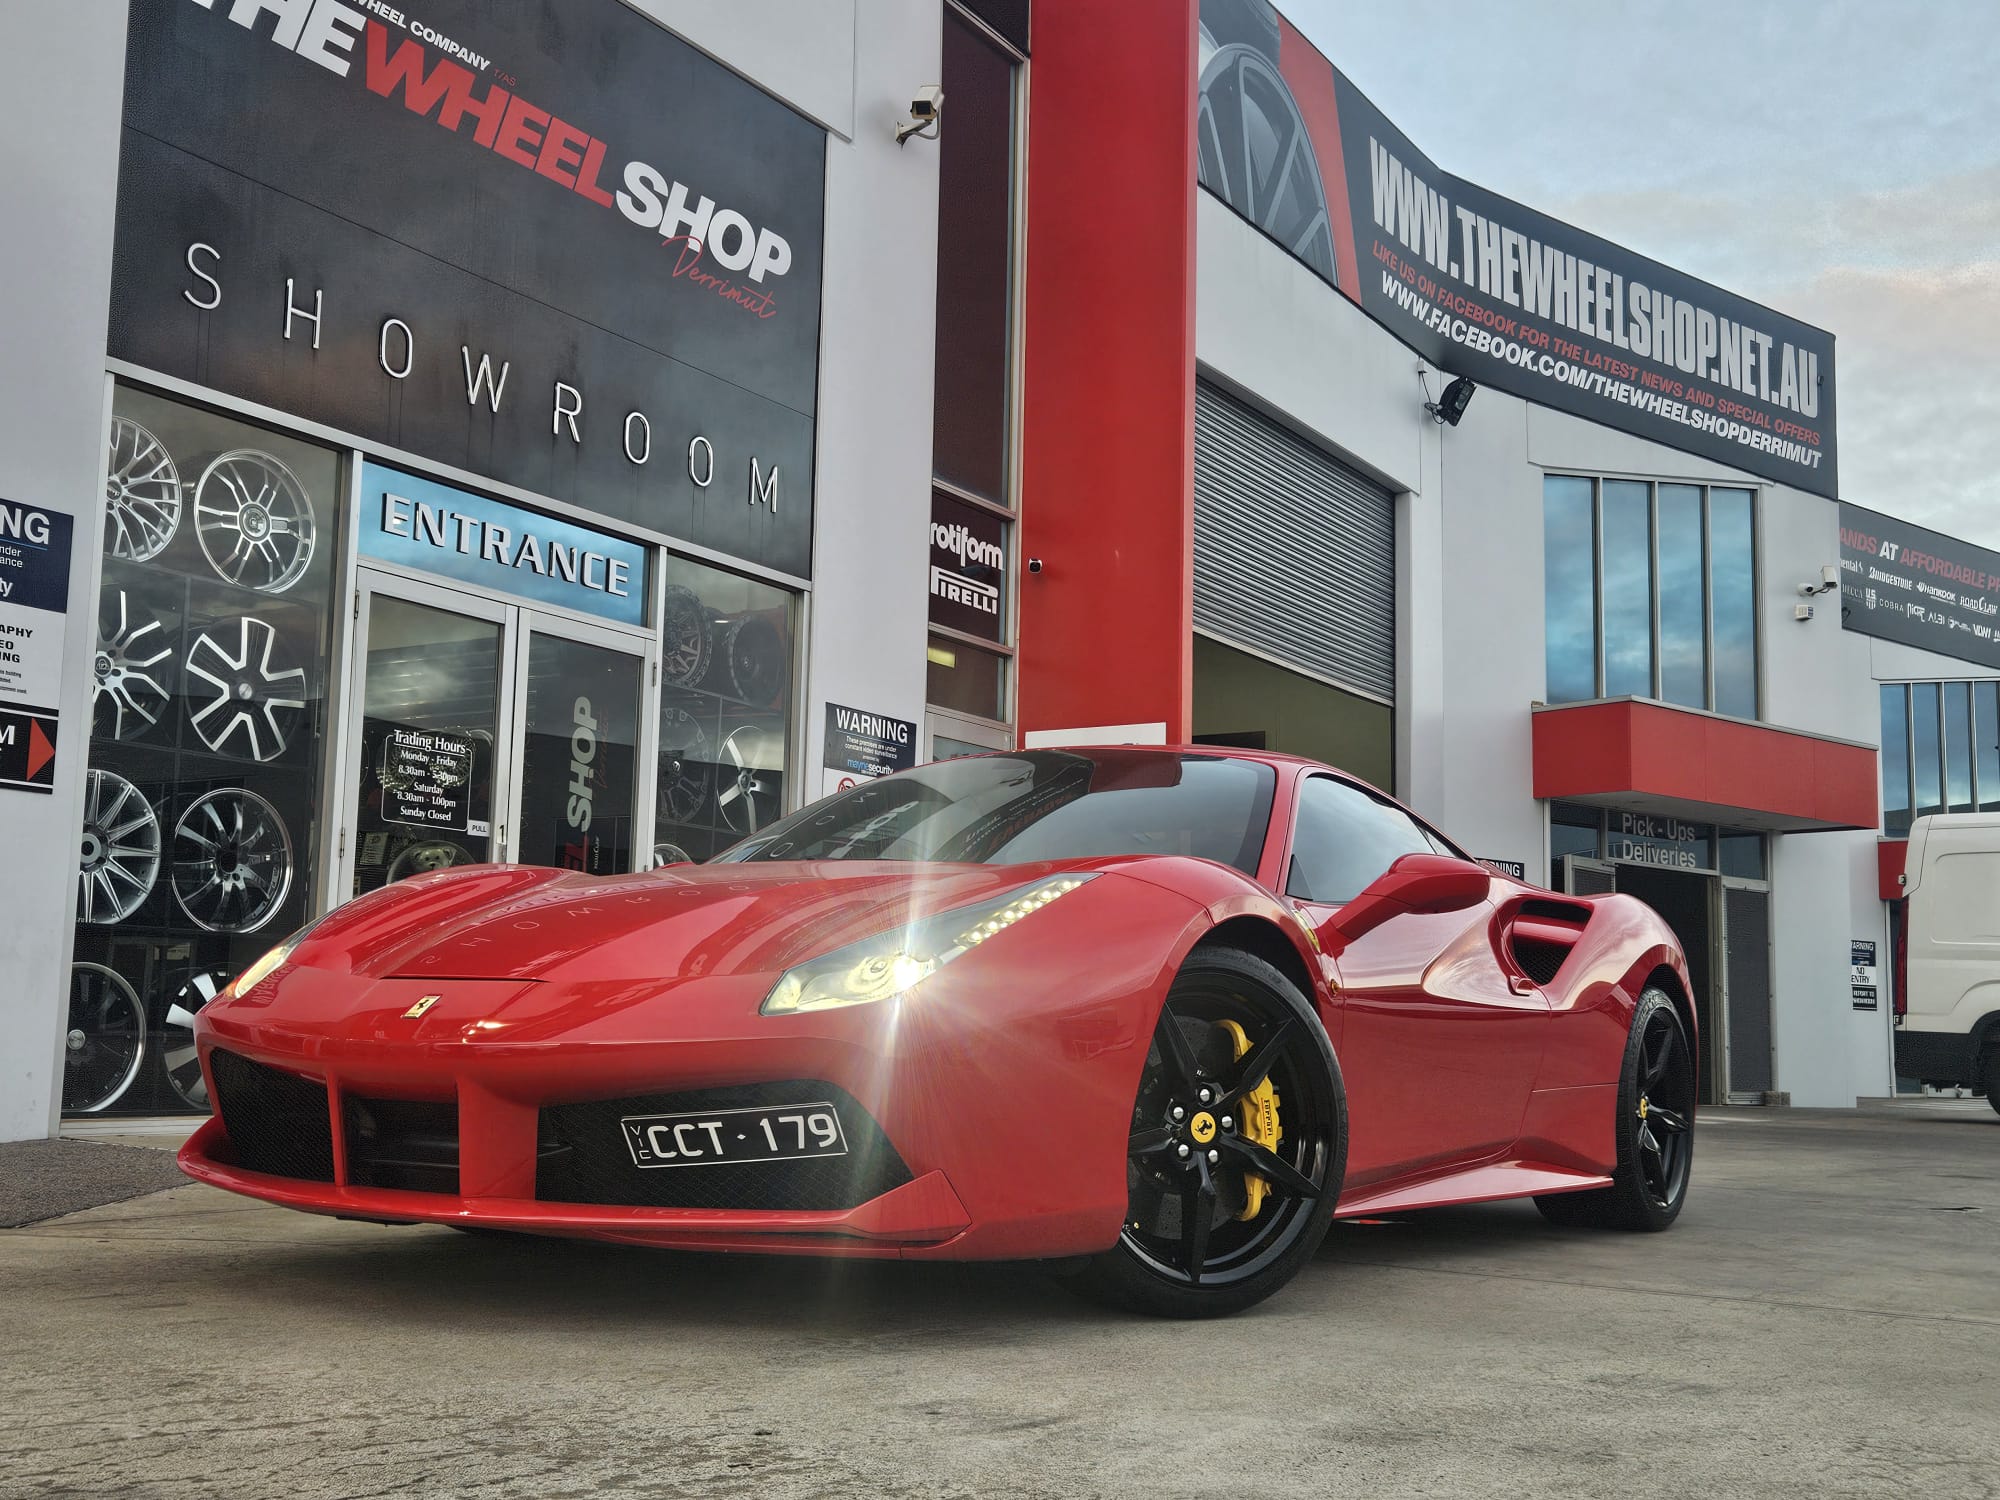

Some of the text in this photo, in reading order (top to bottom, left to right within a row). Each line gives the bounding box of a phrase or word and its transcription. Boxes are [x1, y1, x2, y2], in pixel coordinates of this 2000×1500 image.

[410, 20, 491, 71] COMPANY
[660, 234, 777, 319] Derrimut
[1369, 135, 1819, 419] WWW.THEWHEELSHOP.NET.AU
[1371, 240, 1821, 447] LIKE US ON FACEBOOK FOR THE LATEST NEWS AND SPECIAL OFFERS
[182, 242, 779, 514] SHOWROOM
[1381, 269, 1823, 469] WWW.FACEBOOK.COM/THEWHEELSHOPDERRIMUT
[381, 492, 630, 597] ENTRANCE
[930, 522, 1003, 570] rotiform
[1879, 540, 1899, 561] AT
[1899, 547, 1986, 589] AFFORDABLE
[930, 565, 998, 615] PIRELLI
[393, 729, 466, 754] Trading Hours
[836, 708, 908, 744] WARNING
[398, 764, 425, 777] 8.30am
[400, 750, 429, 764] Monday
[436, 755, 458, 769] Friday
[566, 695, 598, 833] SHOP
[396, 790, 424, 803] 8.30am
[413, 781, 443, 796] Saturday
[400, 805, 452, 821] Sunday Closed
[471, 824, 487, 832] PULL
[1622, 812, 1655, 837] Pick
[1667, 819, 1696, 846] Ups
[1622, 839, 1696, 868] Deliveries
[1850, 974, 1870, 984] ENTRY
[1856, 966, 1865, 975] NO
[1263, 1099, 1273, 1136] Ferrari
[630, 1125, 652, 1160] VIC
[647, 1113, 838, 1159] CCT 179
